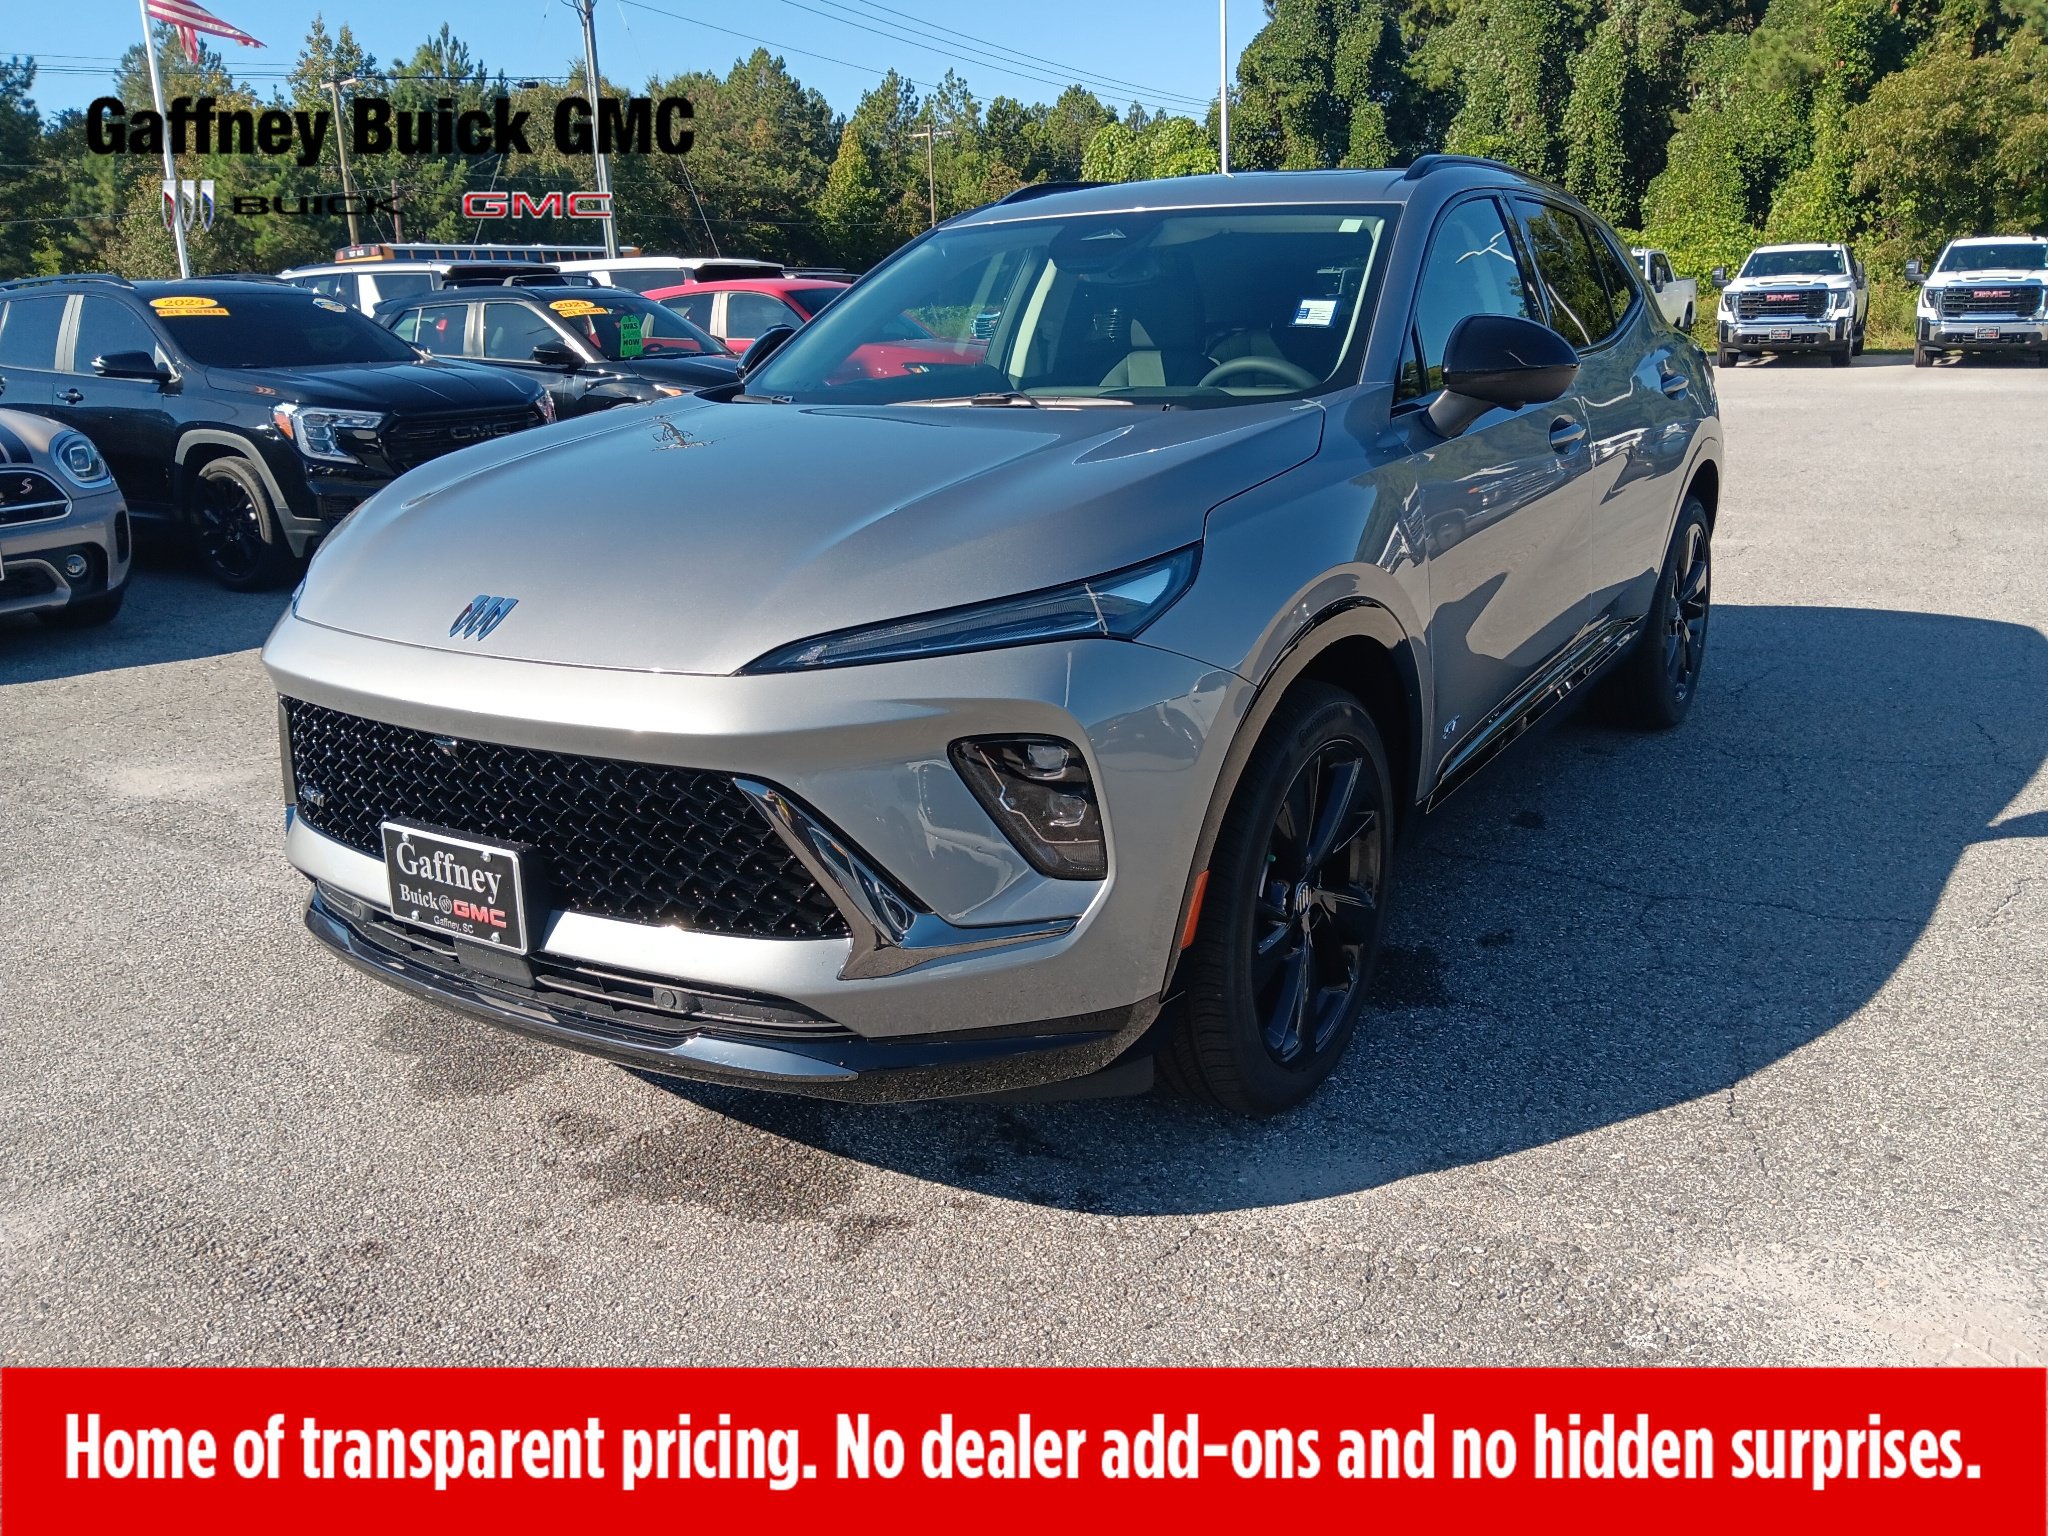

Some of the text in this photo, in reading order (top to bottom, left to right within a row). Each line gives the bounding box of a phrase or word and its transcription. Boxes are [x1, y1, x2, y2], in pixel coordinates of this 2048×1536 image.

[396, 842, 501, 905] Gaffney
[399, 883, 507, 929] Buick GMC
[463, 924, 474, 934] SC
